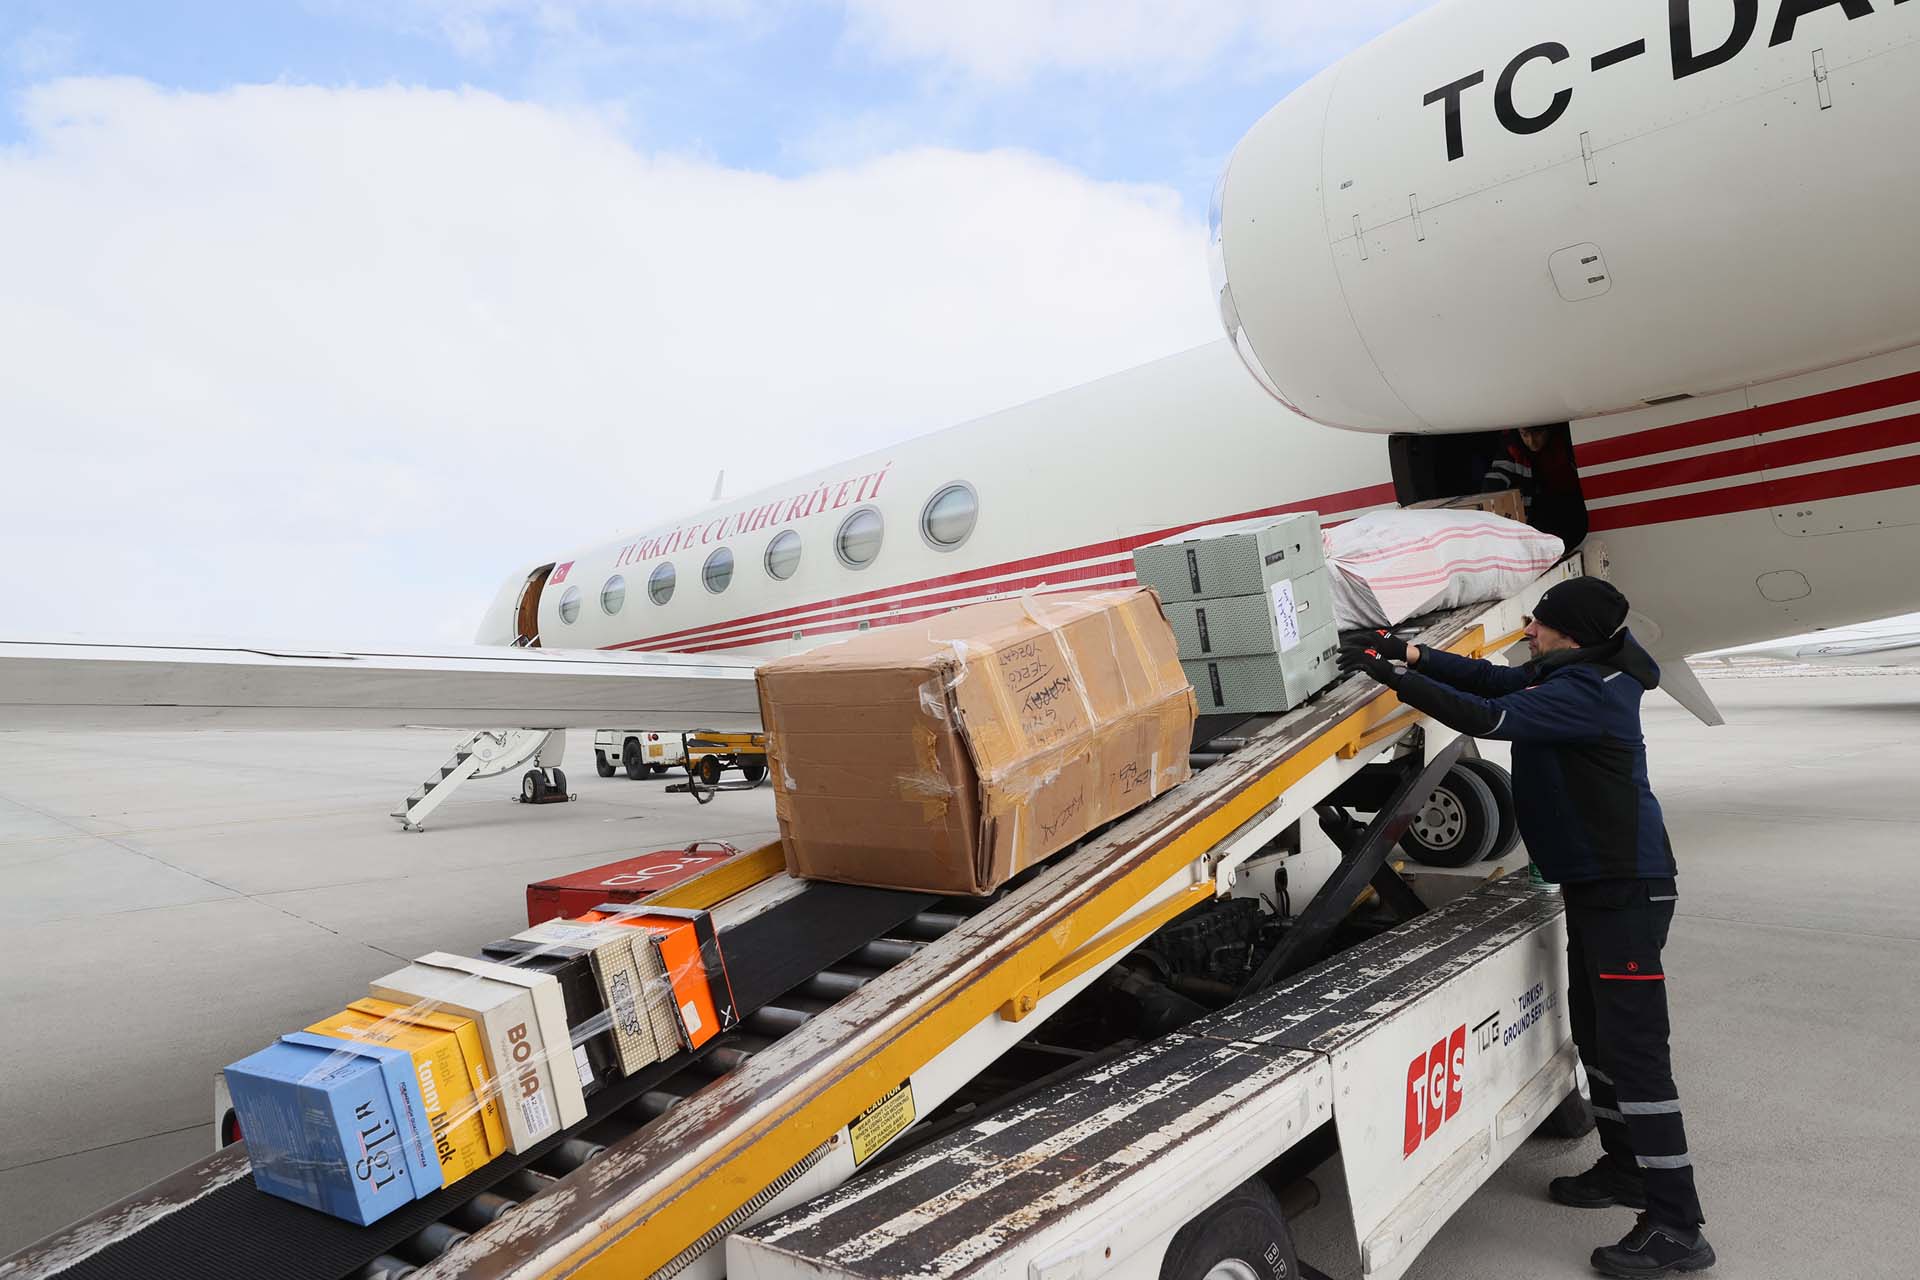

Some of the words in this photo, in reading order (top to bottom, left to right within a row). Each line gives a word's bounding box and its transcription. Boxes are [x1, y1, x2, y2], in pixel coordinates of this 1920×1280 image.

[1423, 0, 1920, 162] TC-D
[615, 523, 703, 568] TÜRKİYE
[701, 461, 893, 545] CUMHURİYETİ
[1471, 1008, 1501, 1056] TUG
[1503, 1012, 1531, 1047] GROUND
[1518, 981, 1544, 1013] TURKISH
[506, 1022, 540, 1098] BONA
[1409, 1041, 1466, 1132] TGS
[417, 1060, 441, 1113] tonny
[431, 1111, 456, 1166] black
[866, 1084, 901, 1115] CAUTION
[880, 1105, 904, 1127] CONVEYOR
[356, 1118, 404, 1192] ilgi
